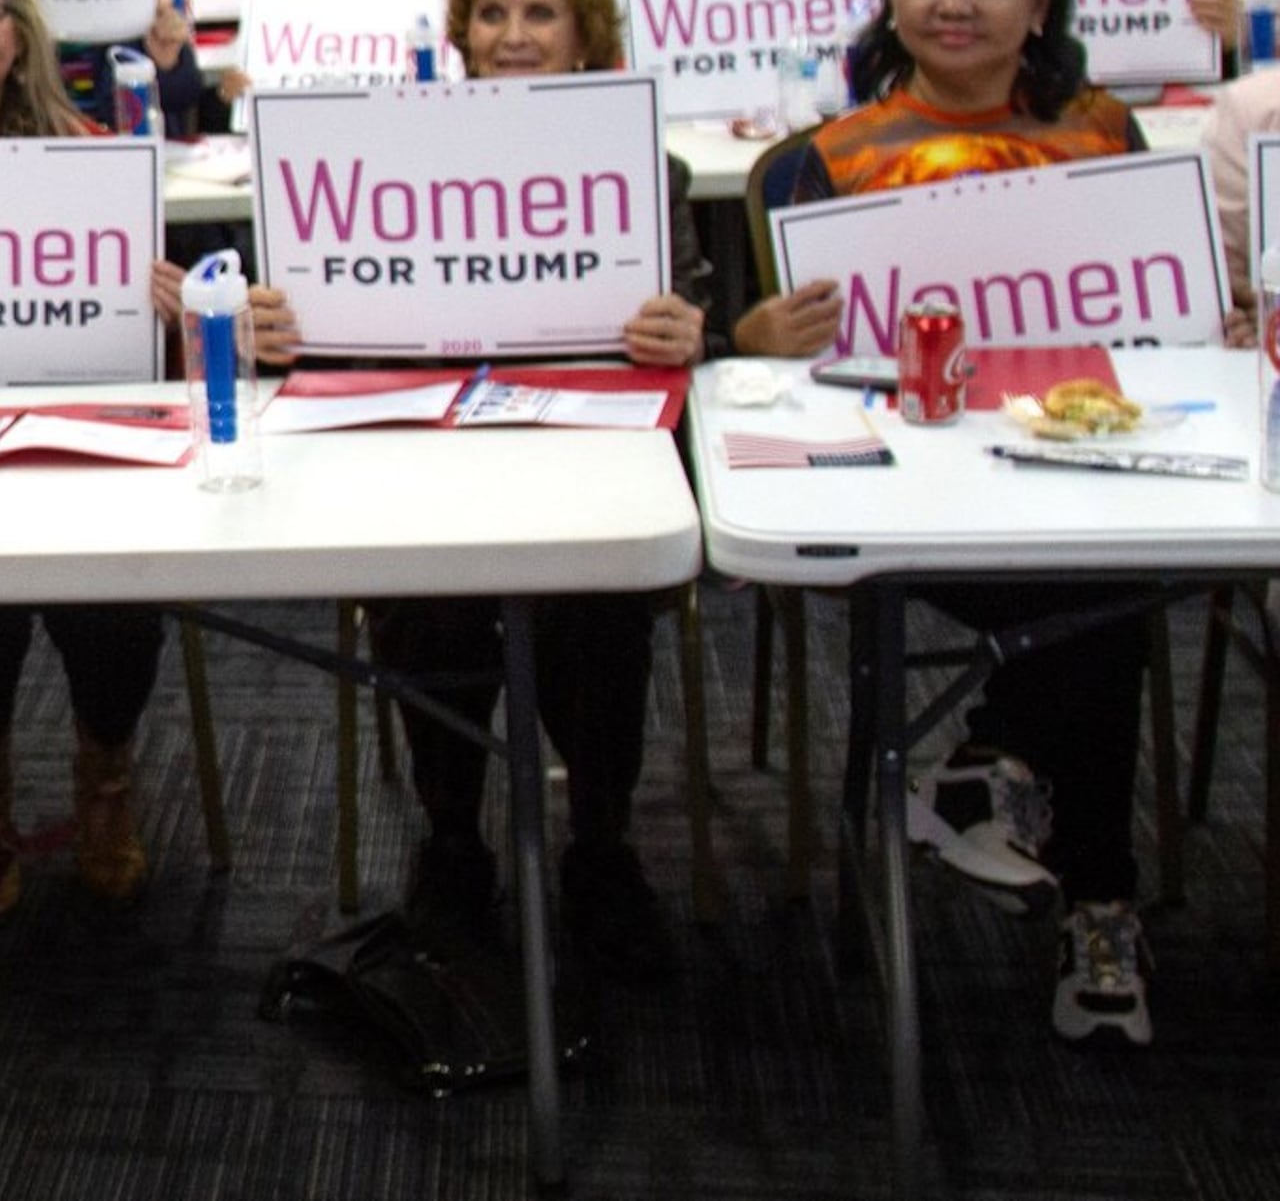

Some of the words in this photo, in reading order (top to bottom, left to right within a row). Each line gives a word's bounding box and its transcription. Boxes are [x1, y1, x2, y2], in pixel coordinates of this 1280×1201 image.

[1079, 12, 1171, 35] RUMP
[674, 53, 735, 75] FOR
[279, 158, 631, 243] Women
[323, 257, 414, 286] FOR
[434, 250, 602, 285] TRUMP
[441, 339, 483, 353] 2020
